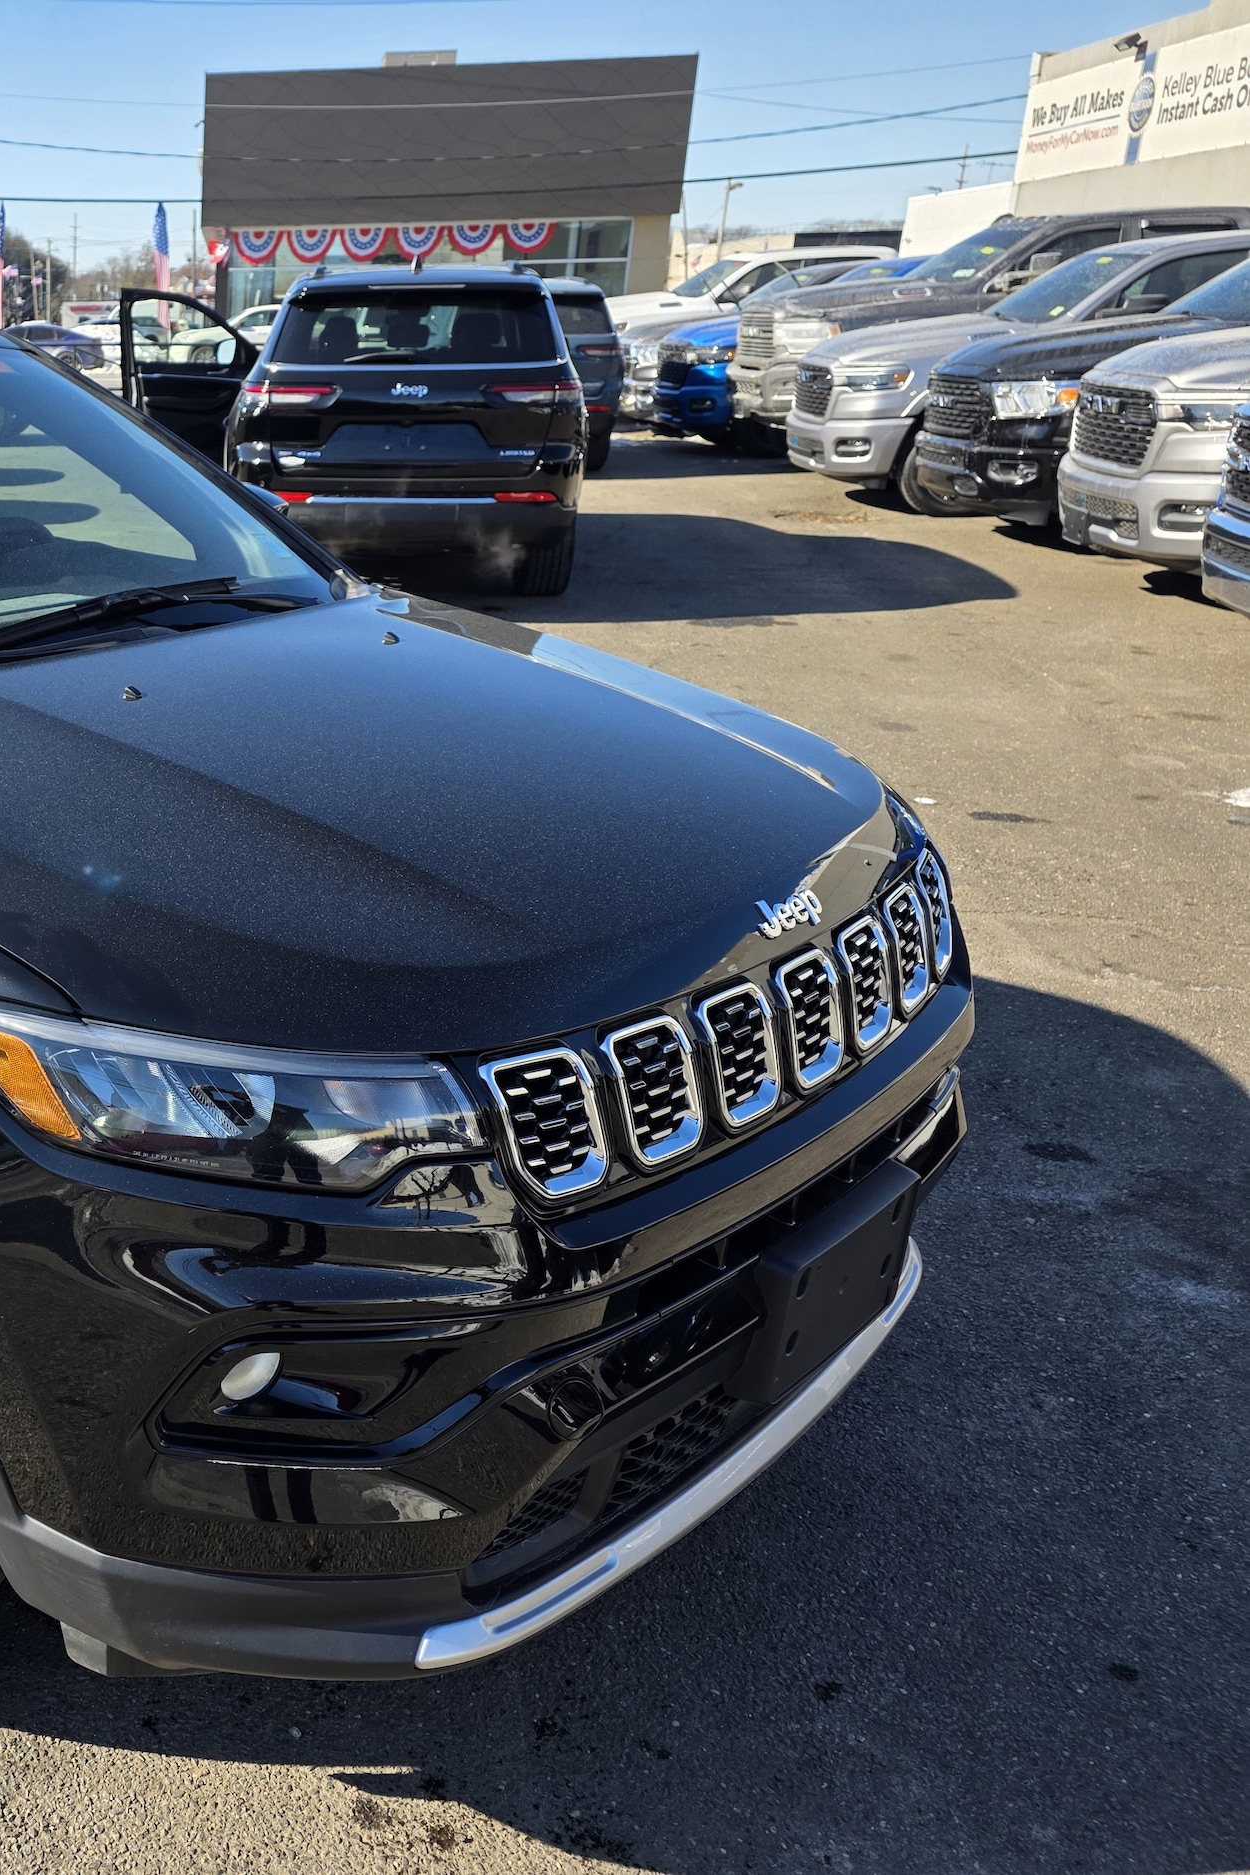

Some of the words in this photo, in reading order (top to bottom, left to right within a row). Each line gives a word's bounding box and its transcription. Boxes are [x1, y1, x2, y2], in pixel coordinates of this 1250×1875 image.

[1162, 71, 1202, 98] Kelley
[1203, 63, 1235, 88] Blue
[1237, 56, 1250, 81] B
[1032, 106, 1047, 128] We
[1048, 103, 1070, 126] Buy
[1070, 94, 1087, 118] All
[1087, 88, 1125, 114] Makes
[1156, 96, 1200, 125] Instant
[1202, 88, 1234, 115] Cash
[1026, 125, 1119, 154] MoneyForMyCarNow.com
[391, 382, 429, 398] Jeep
[754, 890, 823, 939] Jeep
